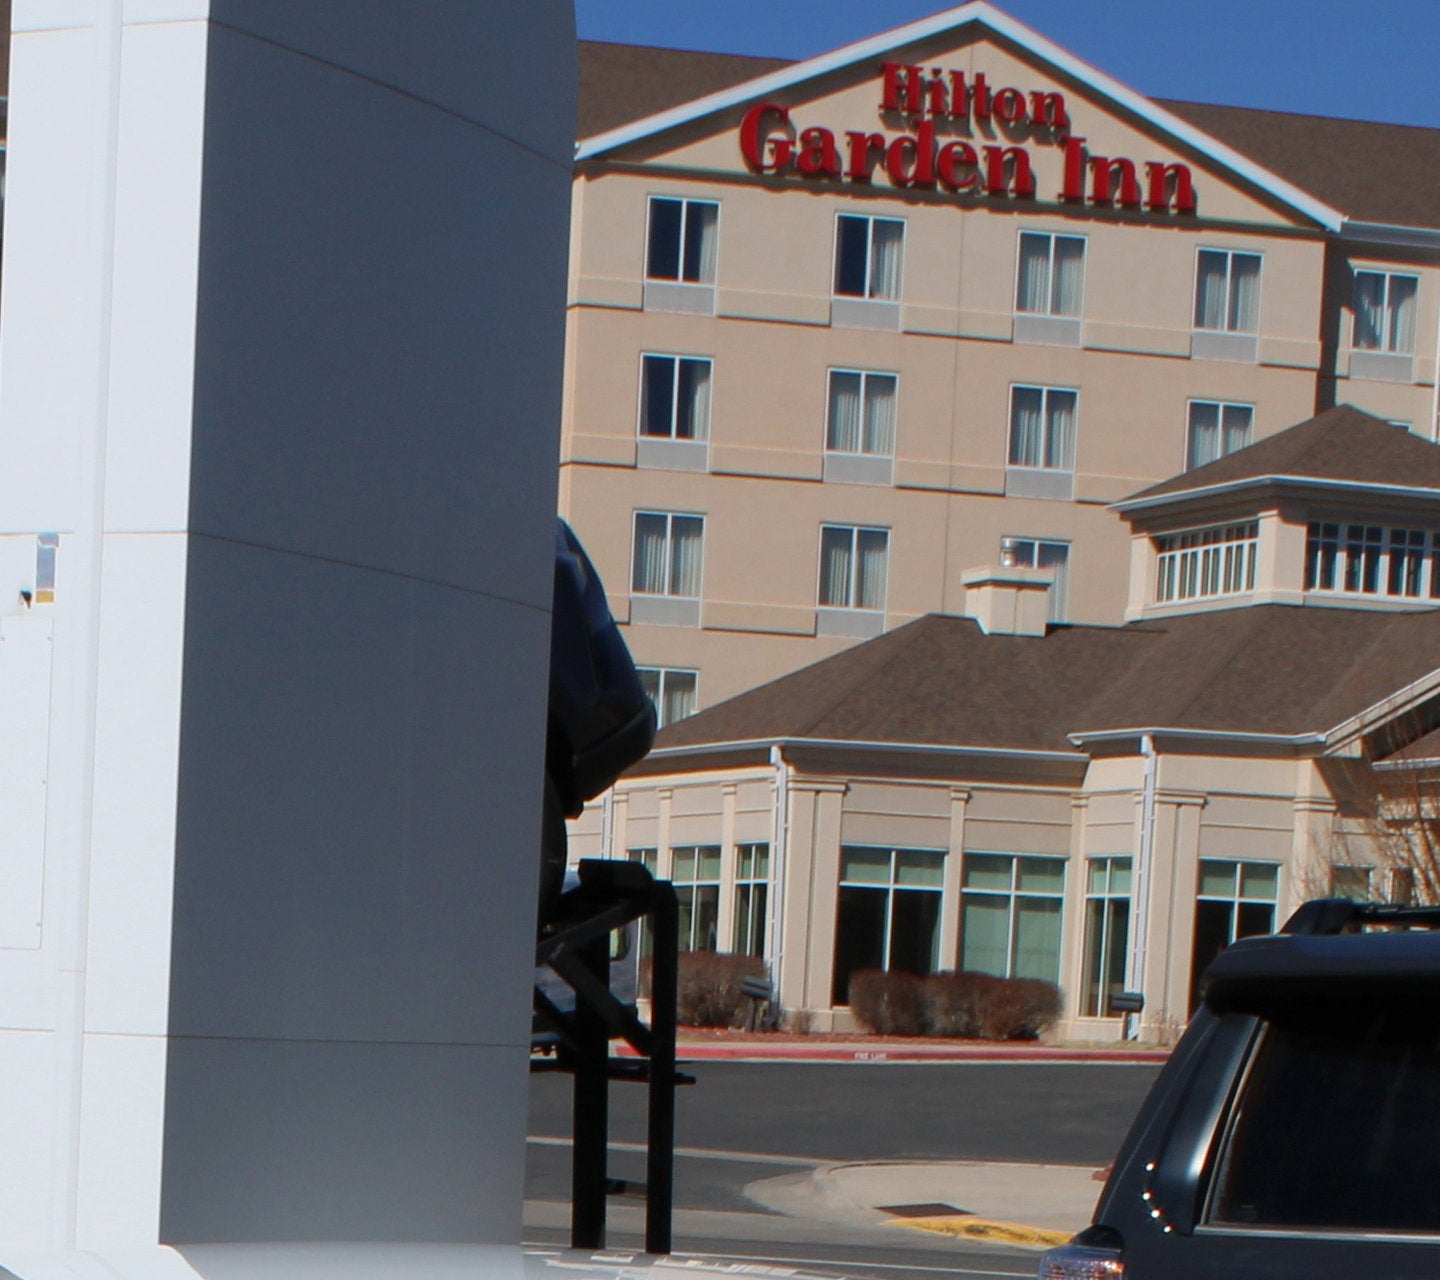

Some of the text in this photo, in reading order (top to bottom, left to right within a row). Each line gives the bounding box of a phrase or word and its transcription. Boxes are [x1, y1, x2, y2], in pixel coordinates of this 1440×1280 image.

[880, 61, 1069, 128] Hilton
[739, 102, 1197, 211] Garden Inn
